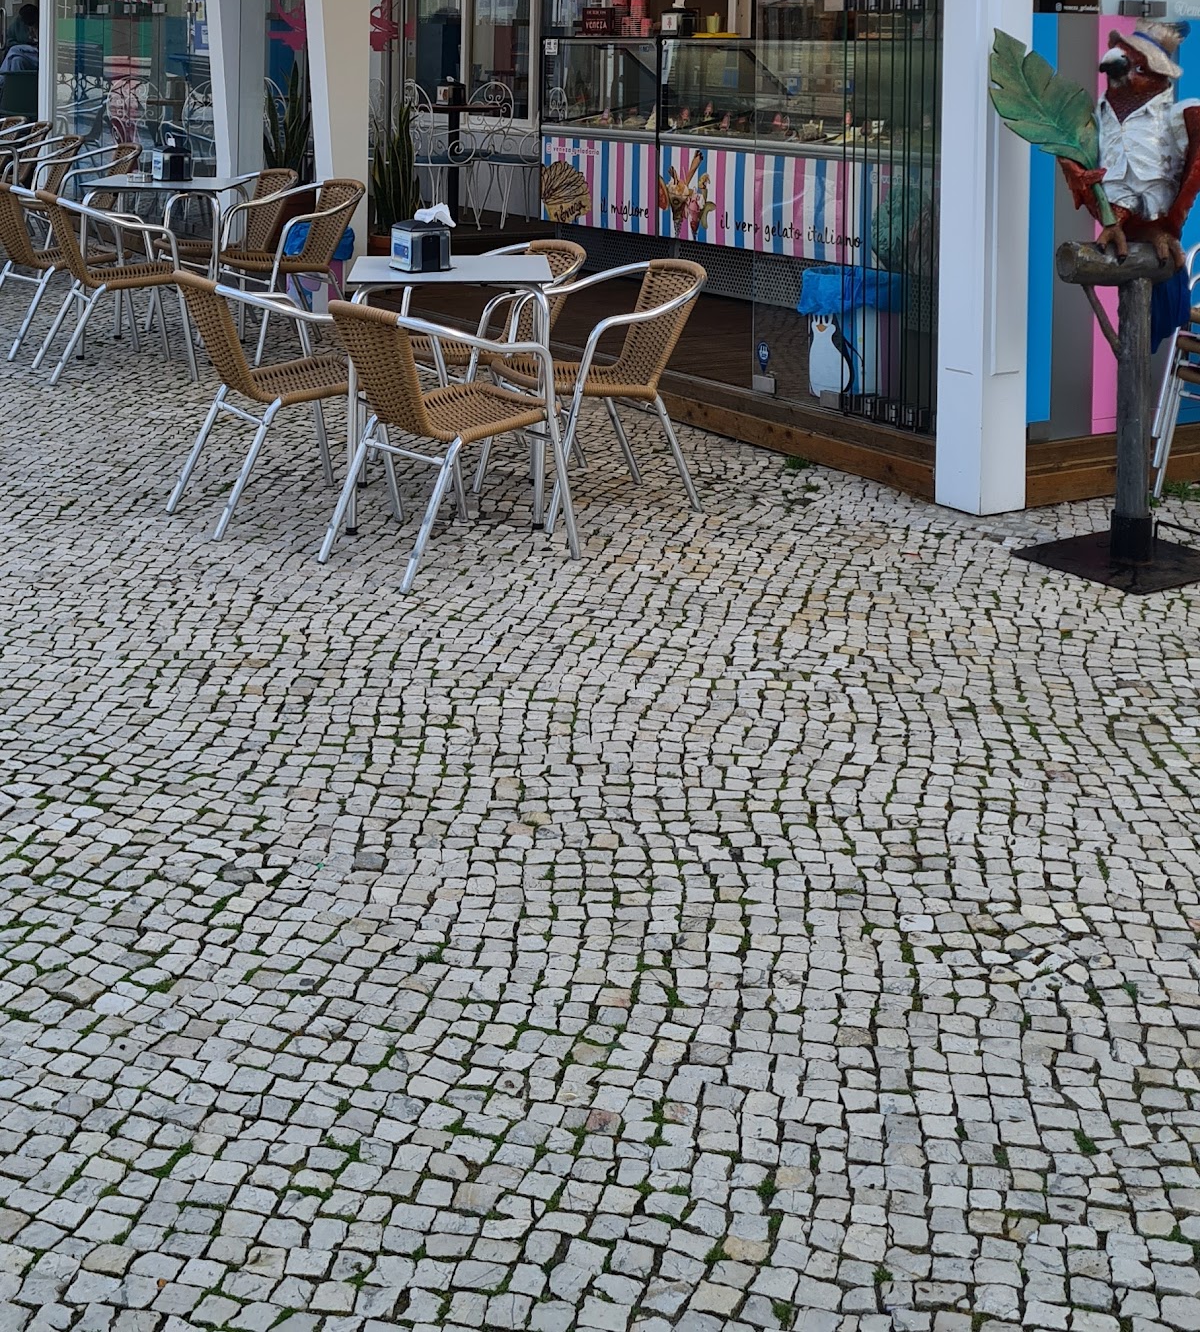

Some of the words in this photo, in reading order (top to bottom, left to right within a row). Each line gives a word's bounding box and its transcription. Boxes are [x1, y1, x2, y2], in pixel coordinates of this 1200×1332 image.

[600, 197, 608, 215] il
[611, 199, 649, 222] migliore
[720, 212, 730, 230] il
[735, 222, 760, 234] vero
[764, 220, 802, 243] gelato
[807, 224, 863, 248] italiano
